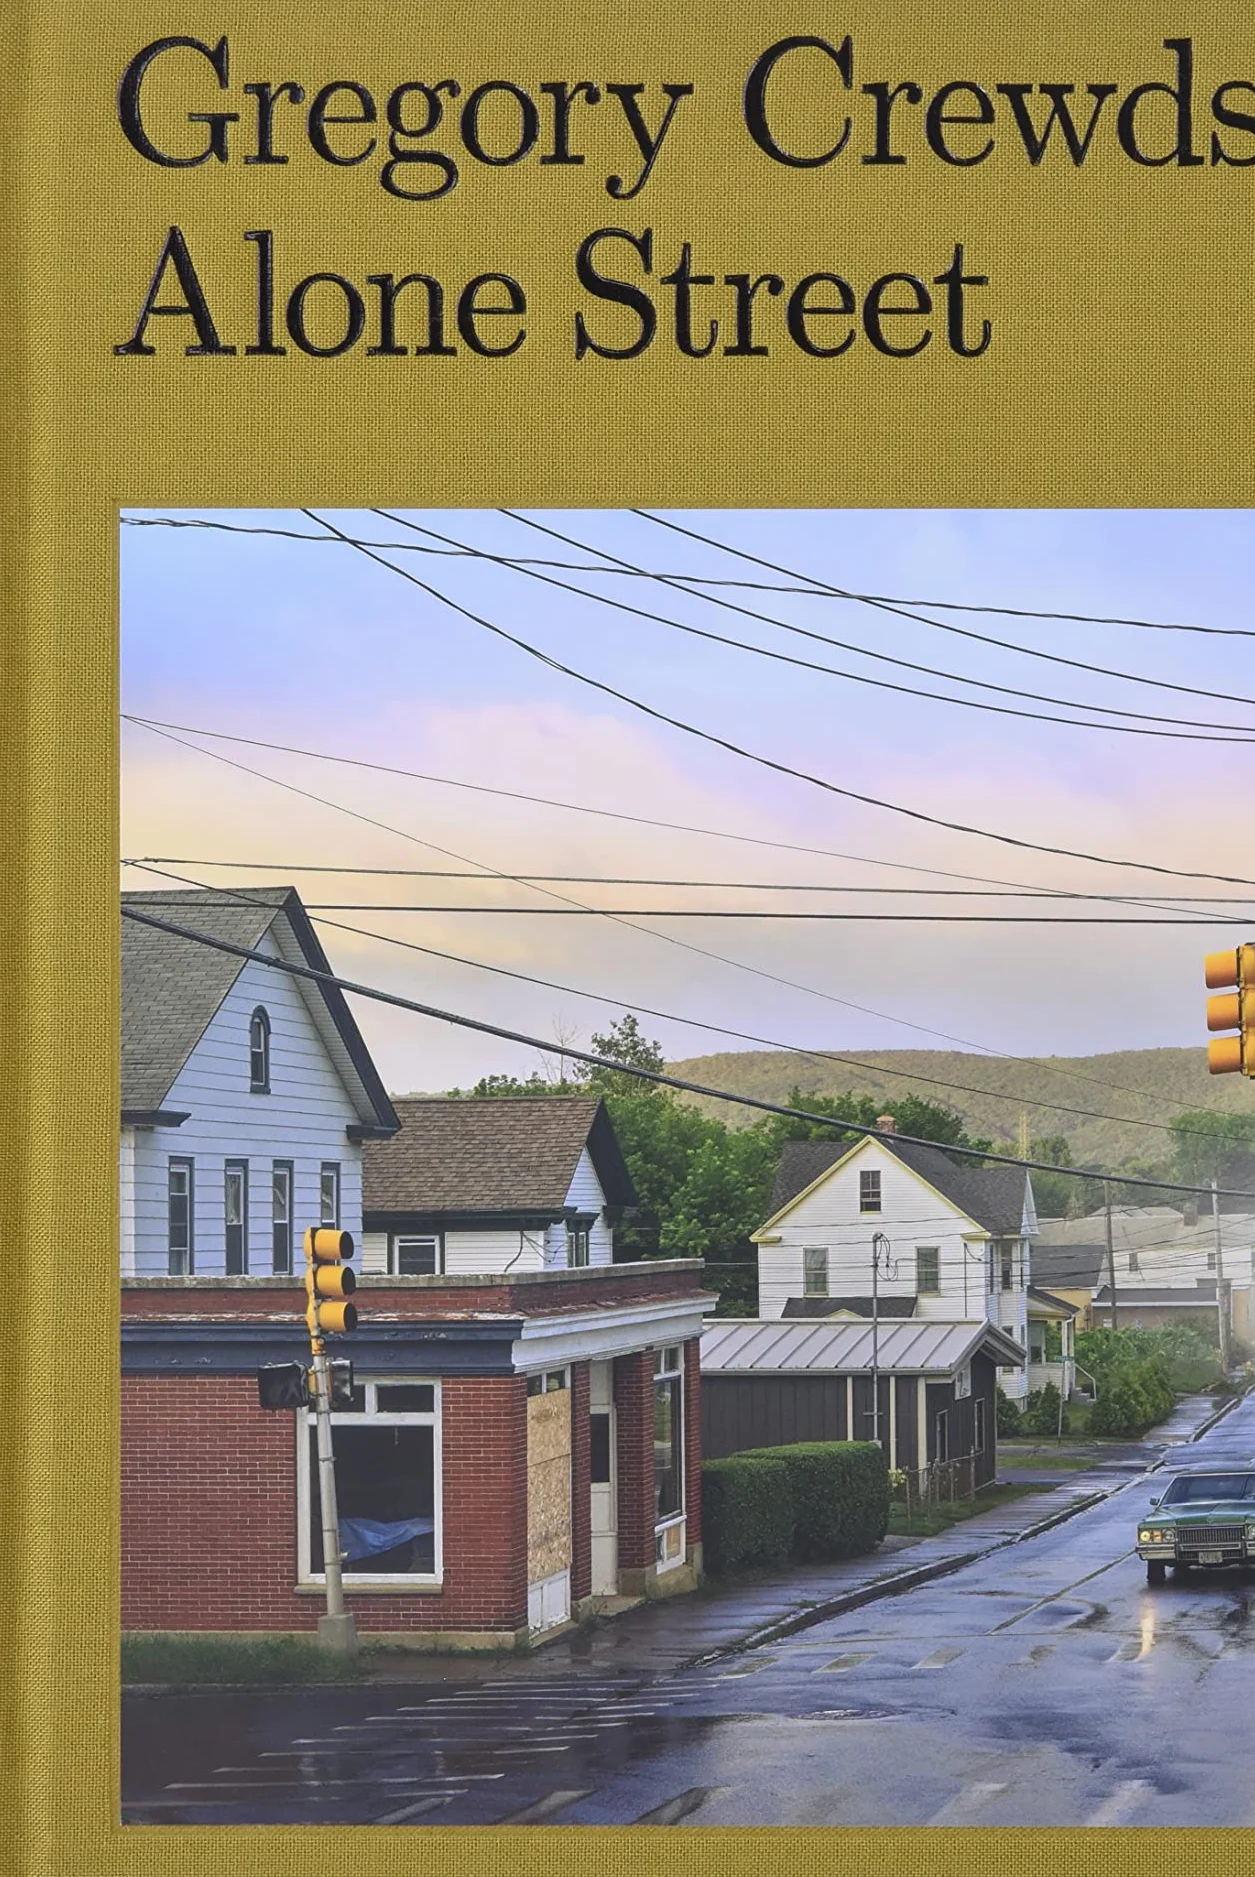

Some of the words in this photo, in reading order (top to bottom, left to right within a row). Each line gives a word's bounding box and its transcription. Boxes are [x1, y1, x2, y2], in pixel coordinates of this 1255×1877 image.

[117, 35, 694, 201] Gregory
[114, 226, 527, 358] Alone
[575, 227, 992, 360] Street
